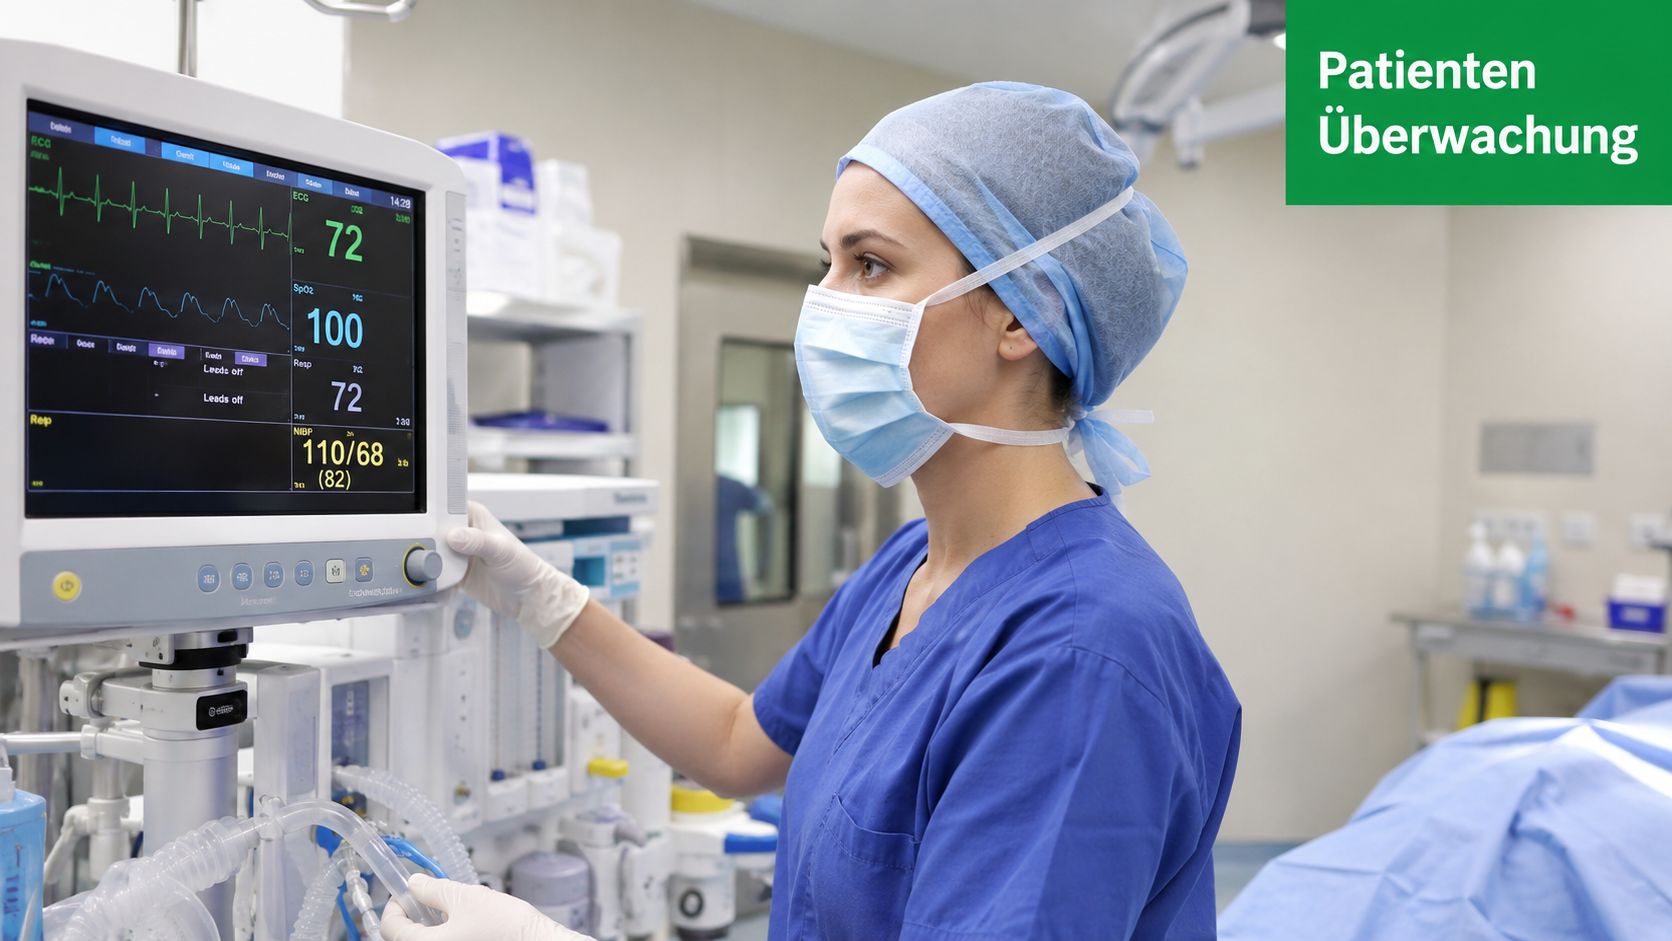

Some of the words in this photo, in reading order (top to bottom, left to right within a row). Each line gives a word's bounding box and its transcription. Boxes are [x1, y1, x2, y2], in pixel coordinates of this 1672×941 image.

[292, 191, 310, 202] ECG
[325, 219, 363, 262] 72
[293, 283, 315, 295] SpO2
[307, 307, 363, 349] 100
[203, 393, 229, 404] Leads
[231, 395, 244, 405] off
[331, 380, 363, 413] 72
[293, 427, 313, 437] NIBP
[302, 438, 384, 467] 110/68
[318, 469, 351, 491] (82)
